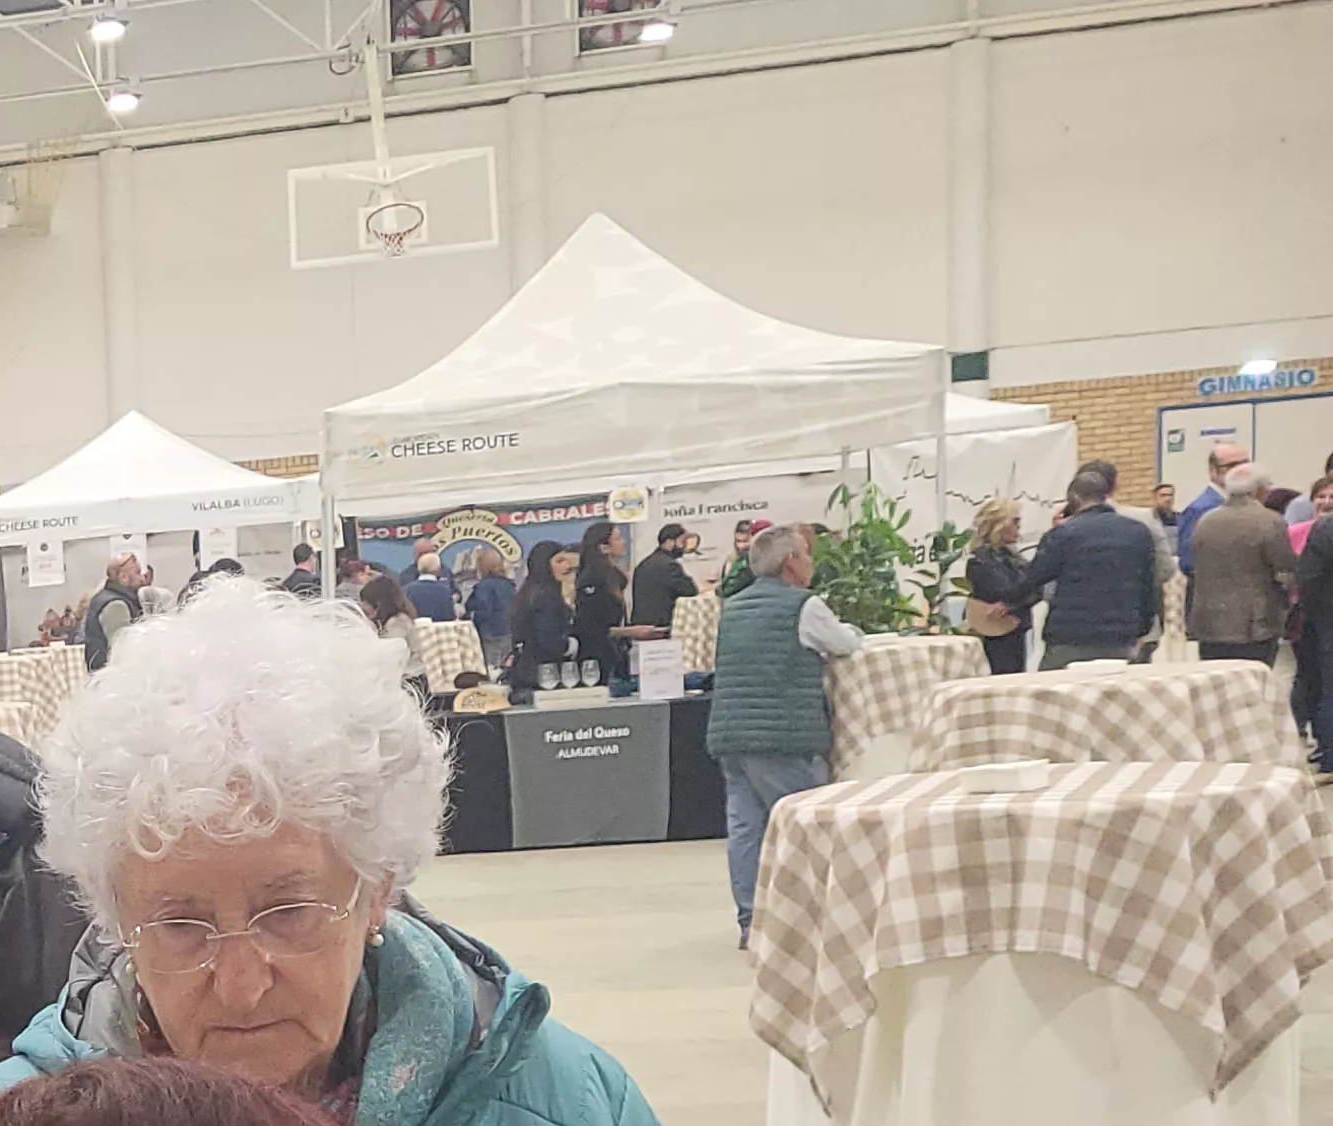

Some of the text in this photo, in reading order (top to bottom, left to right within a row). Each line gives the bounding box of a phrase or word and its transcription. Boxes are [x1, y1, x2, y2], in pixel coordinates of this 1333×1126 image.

[1198, 368, 1316, 396] GIMNASIO
[391, 432, 520, 458] CHEESE ROUTE
[191, 499, 241, 511] VILALBA
[42, 516, 78, 528] ROUTE
[396, 524, 423, 539] DE
[544, 725, 631, 743] Feria del Queso
[555, 744, 620, 759] ALMUDEVAR
